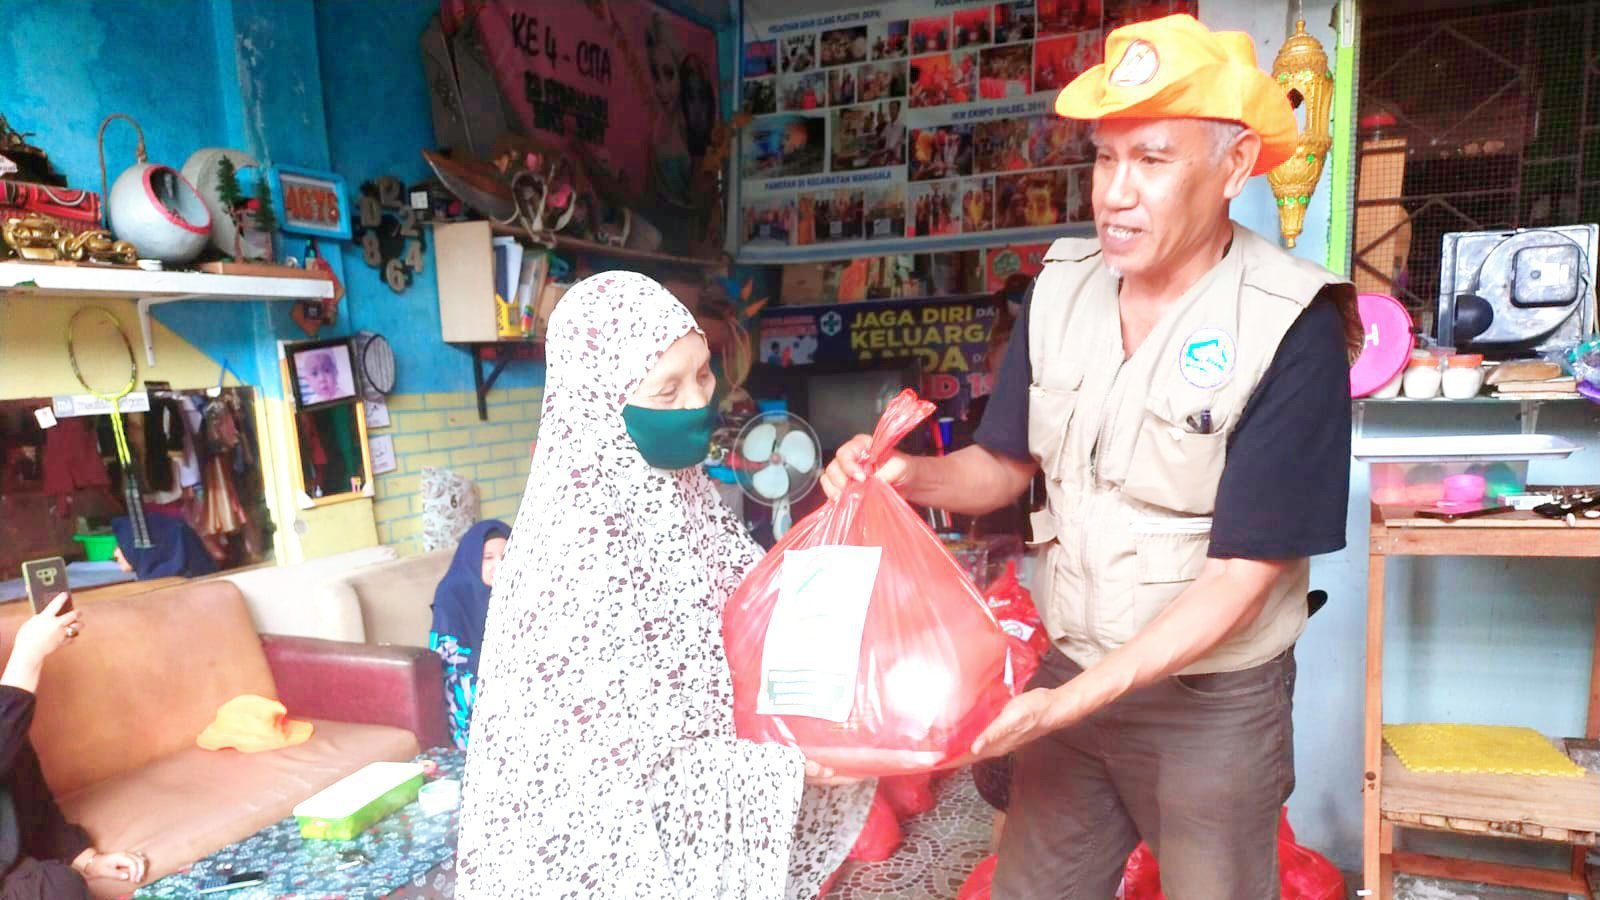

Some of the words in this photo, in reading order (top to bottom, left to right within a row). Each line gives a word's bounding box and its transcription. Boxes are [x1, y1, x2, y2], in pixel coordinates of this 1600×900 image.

[511, 11, 540, 56] KE
[545, 25, 557, 71] 4
[851, 308, 915, 328] JAGA
[922, 305, 972, 324] DIRI
